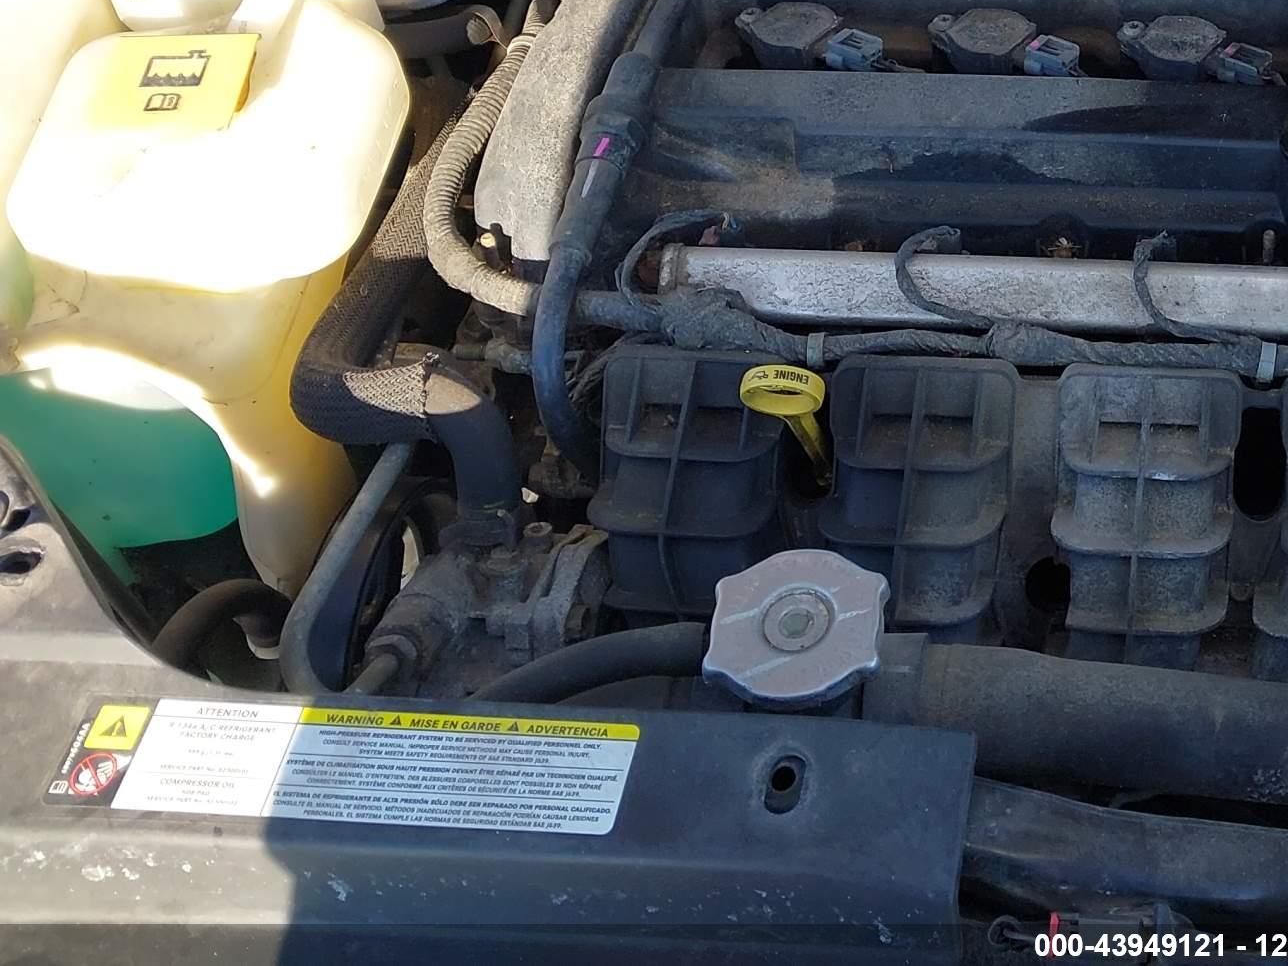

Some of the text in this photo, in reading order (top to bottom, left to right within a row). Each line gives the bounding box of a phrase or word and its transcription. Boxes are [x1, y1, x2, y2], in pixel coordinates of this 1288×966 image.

[773, 369, 809, 385] ENGINE
[196, 707, 259, 718] ATTENTION
[326, 714, 609, 737] WARNING MISE EN GARDE ADVERTENCIA
